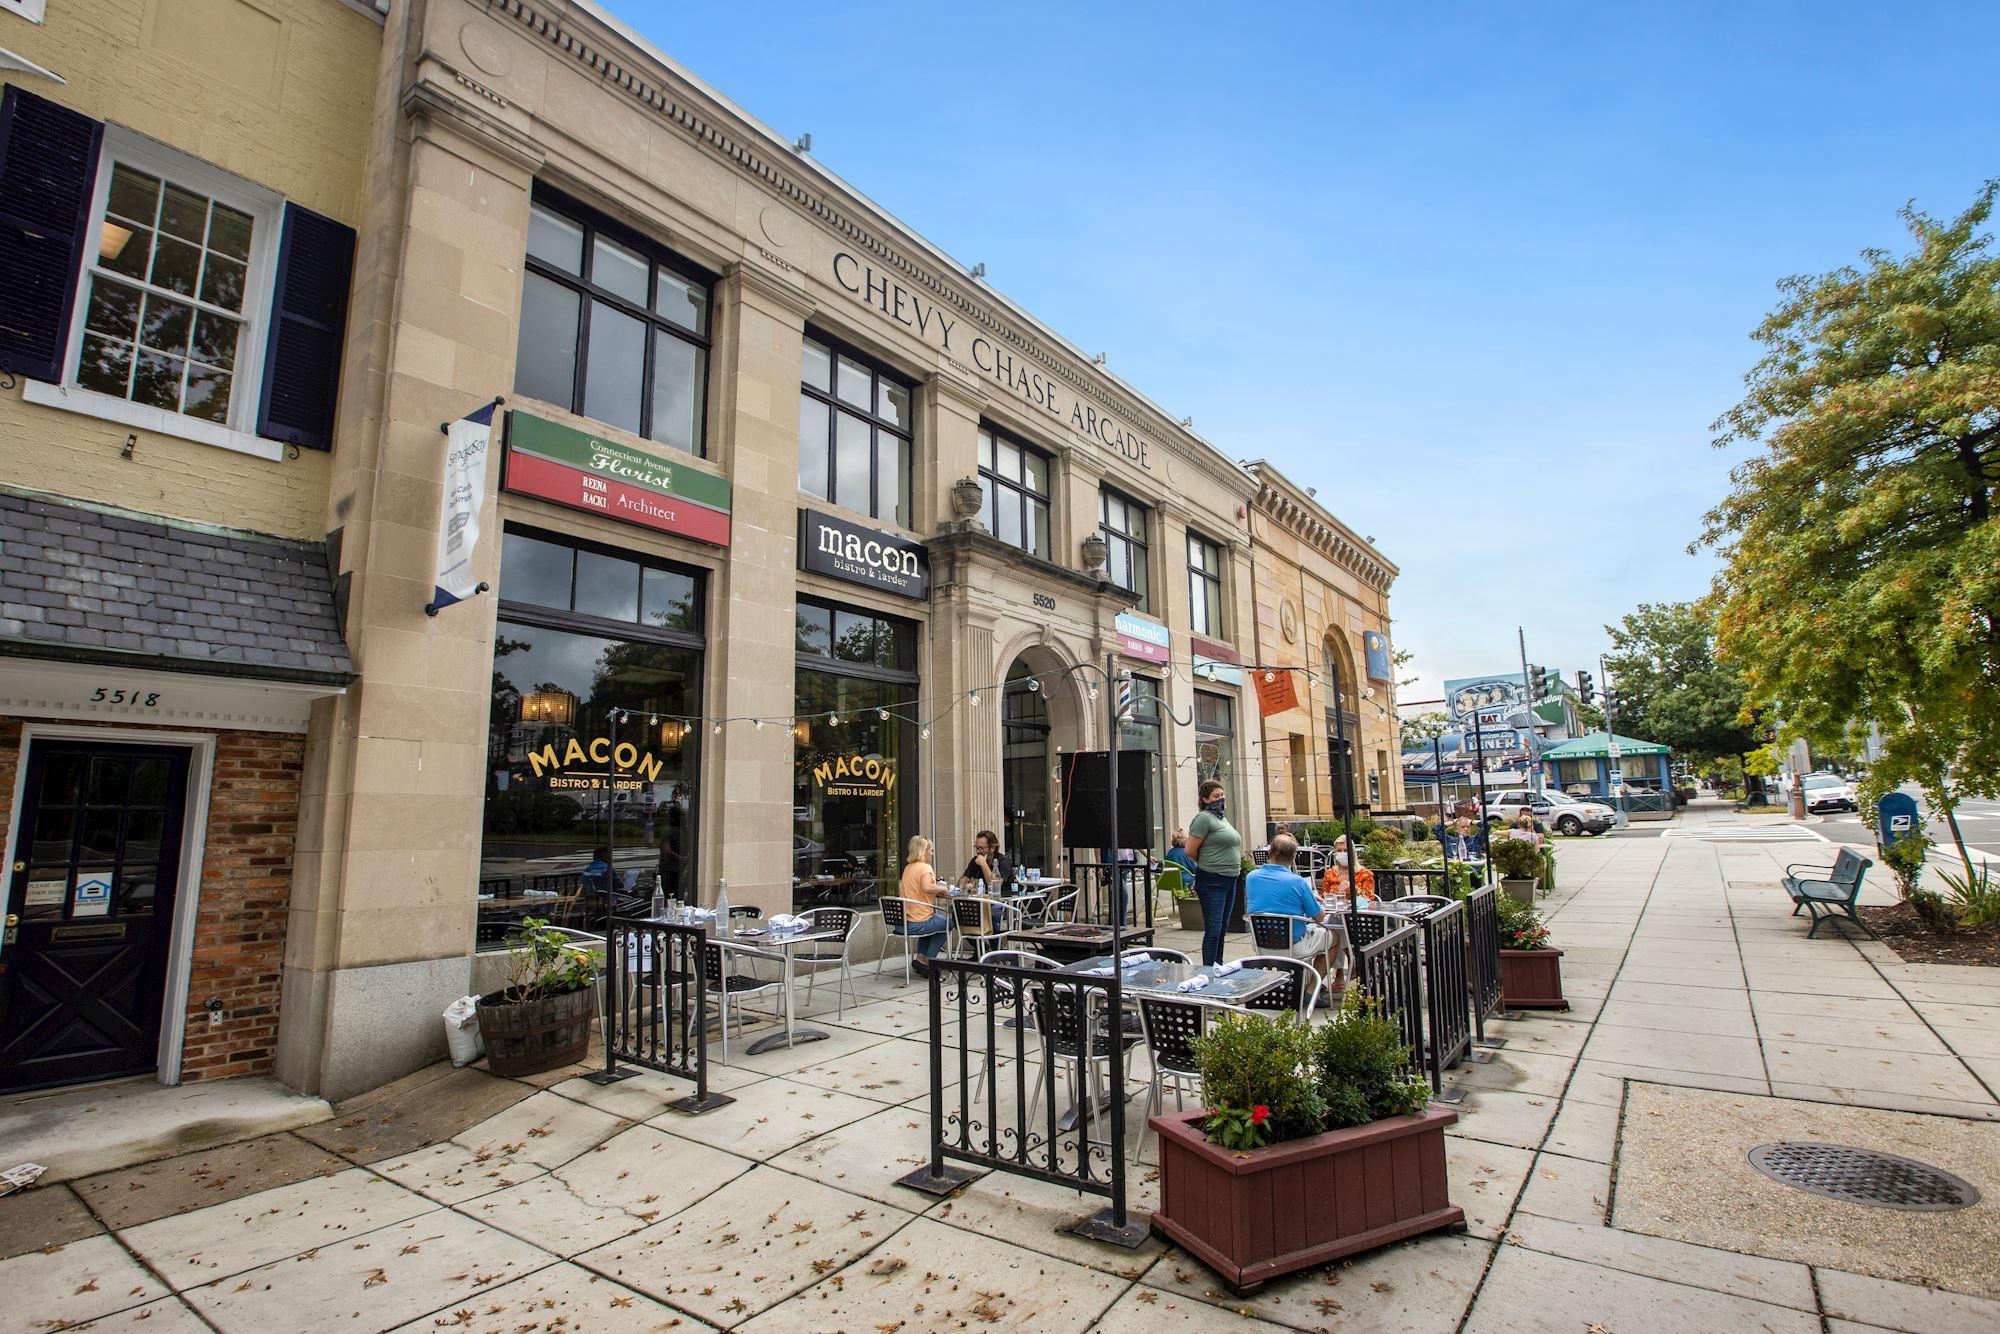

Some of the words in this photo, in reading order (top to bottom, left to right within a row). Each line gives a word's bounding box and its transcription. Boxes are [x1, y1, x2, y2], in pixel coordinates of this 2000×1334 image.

[832, 252, 956, 351] CHEVY
[972, 338, 1061, 415] CHASE
[1071, 401, 1152, 470] ARCADE
[590, 440, 642, 464] Connecticut
[643, 458, 672, 474] Avenue
[589, 454, 671, 489] Florist
[583, 476, 607, 493] REENA
[583, 492, 607, 508] RACKI
[617, 493, 676, 522] Architect
[818, 525, 921, 579] macon
[834, 558, 866, 575] bistro
[868, 567, 875, 578] &
[878, 570, 907, 587] larder
[1033, 592, 1056, 611] 5520
[89, 687, 161, 707] 5518
[1544, 694, 1564, 707] Way
[1480, 714, 1498, 723] EAT
[1469, 738, 1516, 751] DINER
[527, 737, 664, 783] MACON
[549, 777, 590, 789] BISTRO
[592, 778, 600, 789] &
[813, 755, 896, 791] MACON
[827, 787, 851, 796] BISTRO
[859, 788, 884, 797] LARDER
